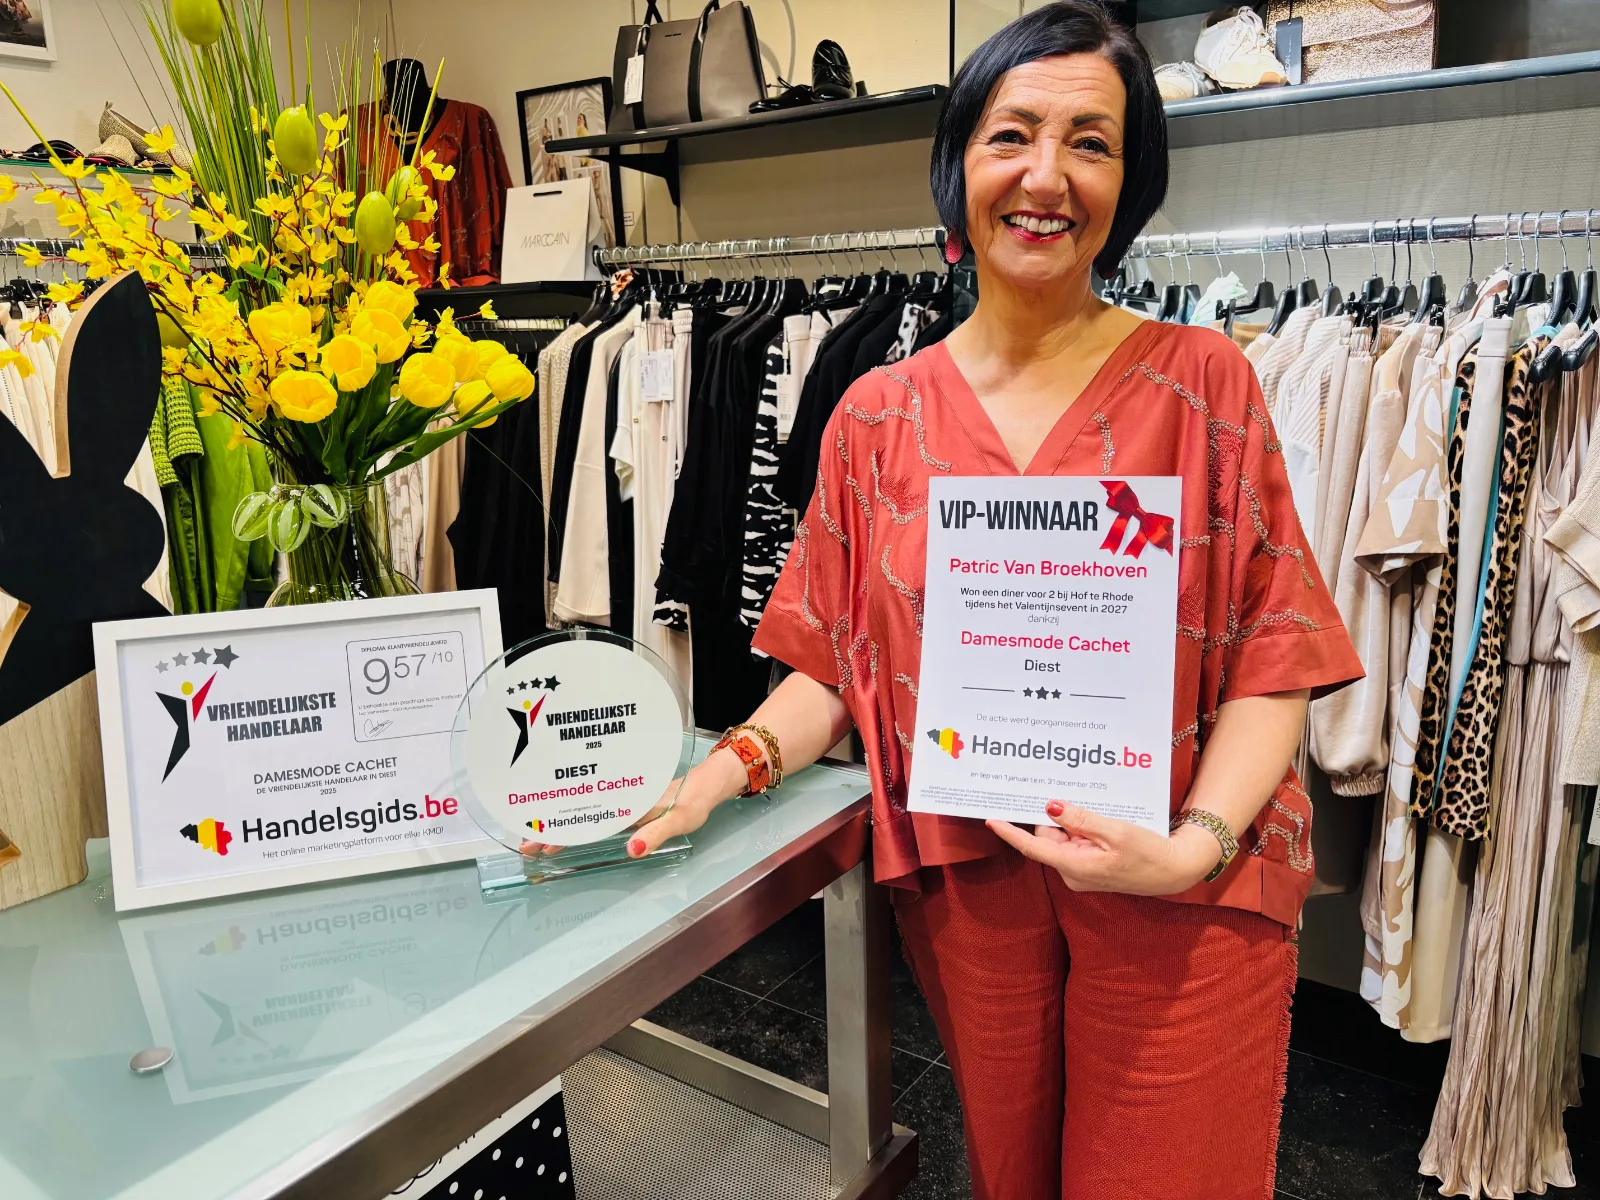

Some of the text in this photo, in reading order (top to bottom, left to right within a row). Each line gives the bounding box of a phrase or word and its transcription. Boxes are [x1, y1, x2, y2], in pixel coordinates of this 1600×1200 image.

[939, 500, 1099, 531] VIP-WINNAAR
[949, 558, 1148, 578] Patric Van Broekhoven
[960, 588, 1134, 602] Won een diner voor 2 bij Hof te Rhode
[965, 600, 1128, 614] tijdens het Valentijnsevent in 2027
[1027, 614, 1060, 626] dankzij
[361, 645, 386, 653] DIPLOMA
[961, 631, 1131, 653] Damesmode Cachet
[1024, 659, 1061, 673] Diest
[207, 692, 337, 722] VRIENDELIJKSTE
[546, 703, 637, 726] VRIENDELIJKSTE
[227, 716, 323, 742] HANDELAAR
[559, 721, 626, 741] HANDELAAR
[976, 713, 988, 721] De
[988, 714, 1008, 723] actie
[1030, 717, 1087, 728] georganiseerd
[1088, 722, 1107, 730] door
[585, 741, 602, 750] 2025
[971, 734, 1152, 769] Handelsgids.be
[253, 757, 398, 785] DAMESMODE CACHET
[554, 763, 598, 780] DIEST
[268, 780, 323, 793] VRIENDELIJKSTE
[324, 775, 368, 786] HANDELAAR
[379, 771, 397, 779] DIEST
[320, 788, 337, 796] 2025
[508, 775, 644, 805] Damesmode Cachet
[1056, 779, 1088, 788] december
[1089, 782, 1108, 790] 2025
[242, 795, 459, 843] Handelsgids.be
[548, 808, 631, 829] Handelsgids.be
[262, 826, 444, 859] Het online marketingplatform voor elke KMO!
